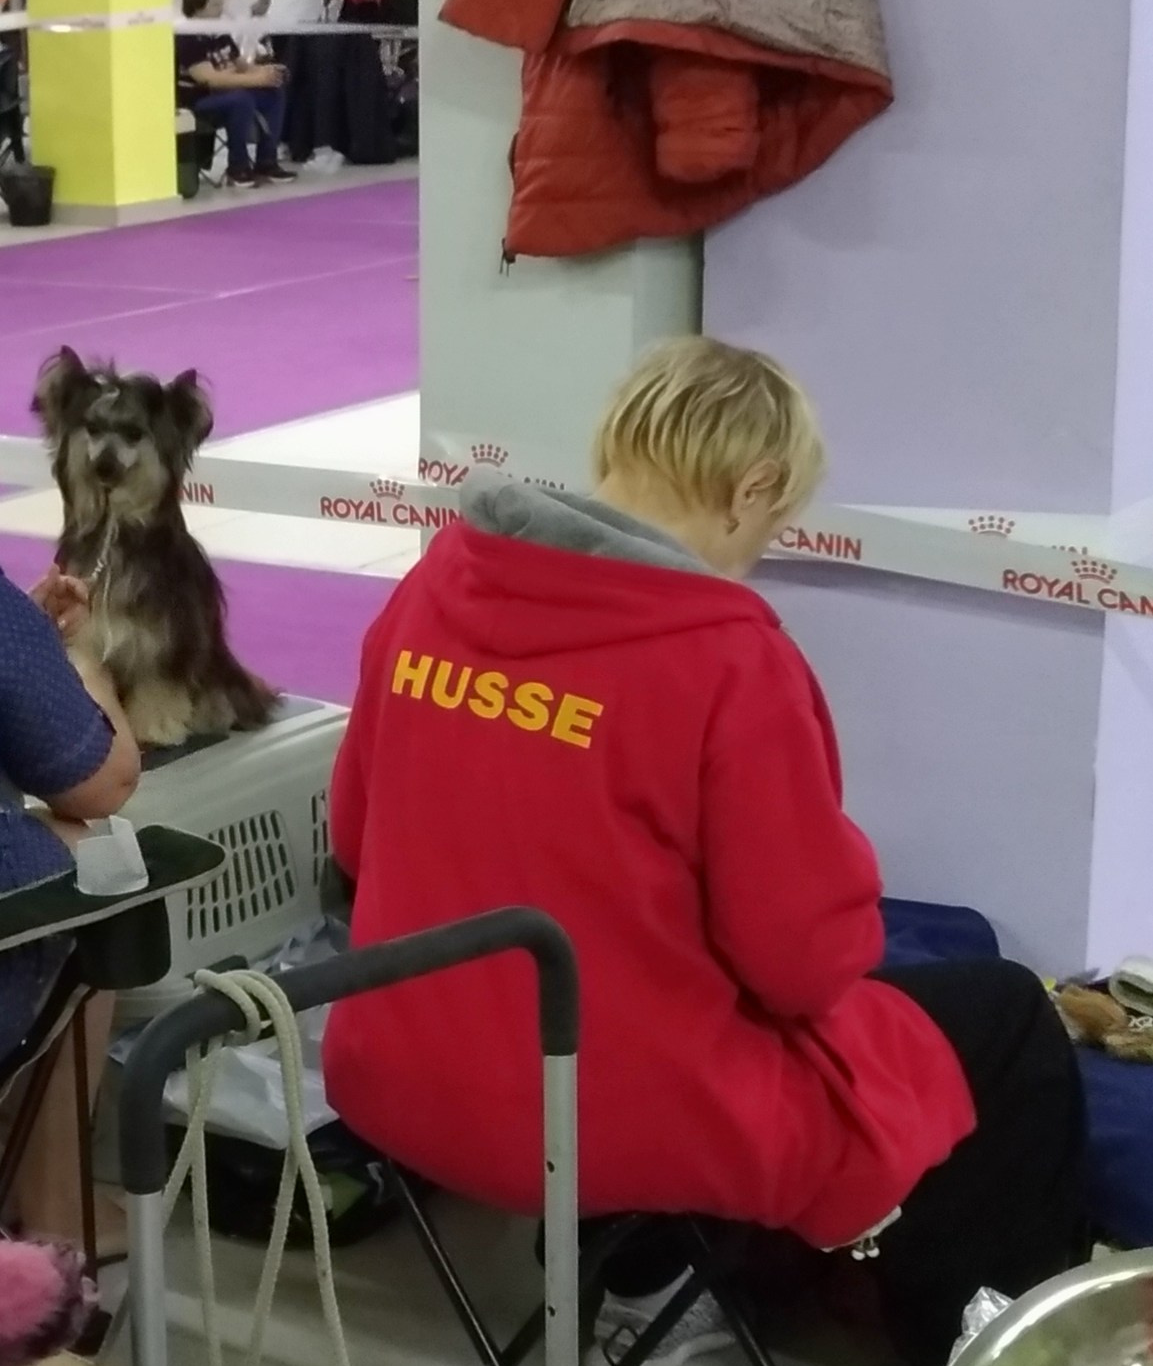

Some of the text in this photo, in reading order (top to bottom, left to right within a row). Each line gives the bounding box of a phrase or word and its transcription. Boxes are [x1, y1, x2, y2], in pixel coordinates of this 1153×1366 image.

[418, 457, 469, 486] ROYA
[320, 496, 387, 523] ROYAL
[777, 525, 863, 561] CANIN
[1003, 569, 1153, 615] ROYAL CAN
[391, 650, 604, 749] HUSSE
